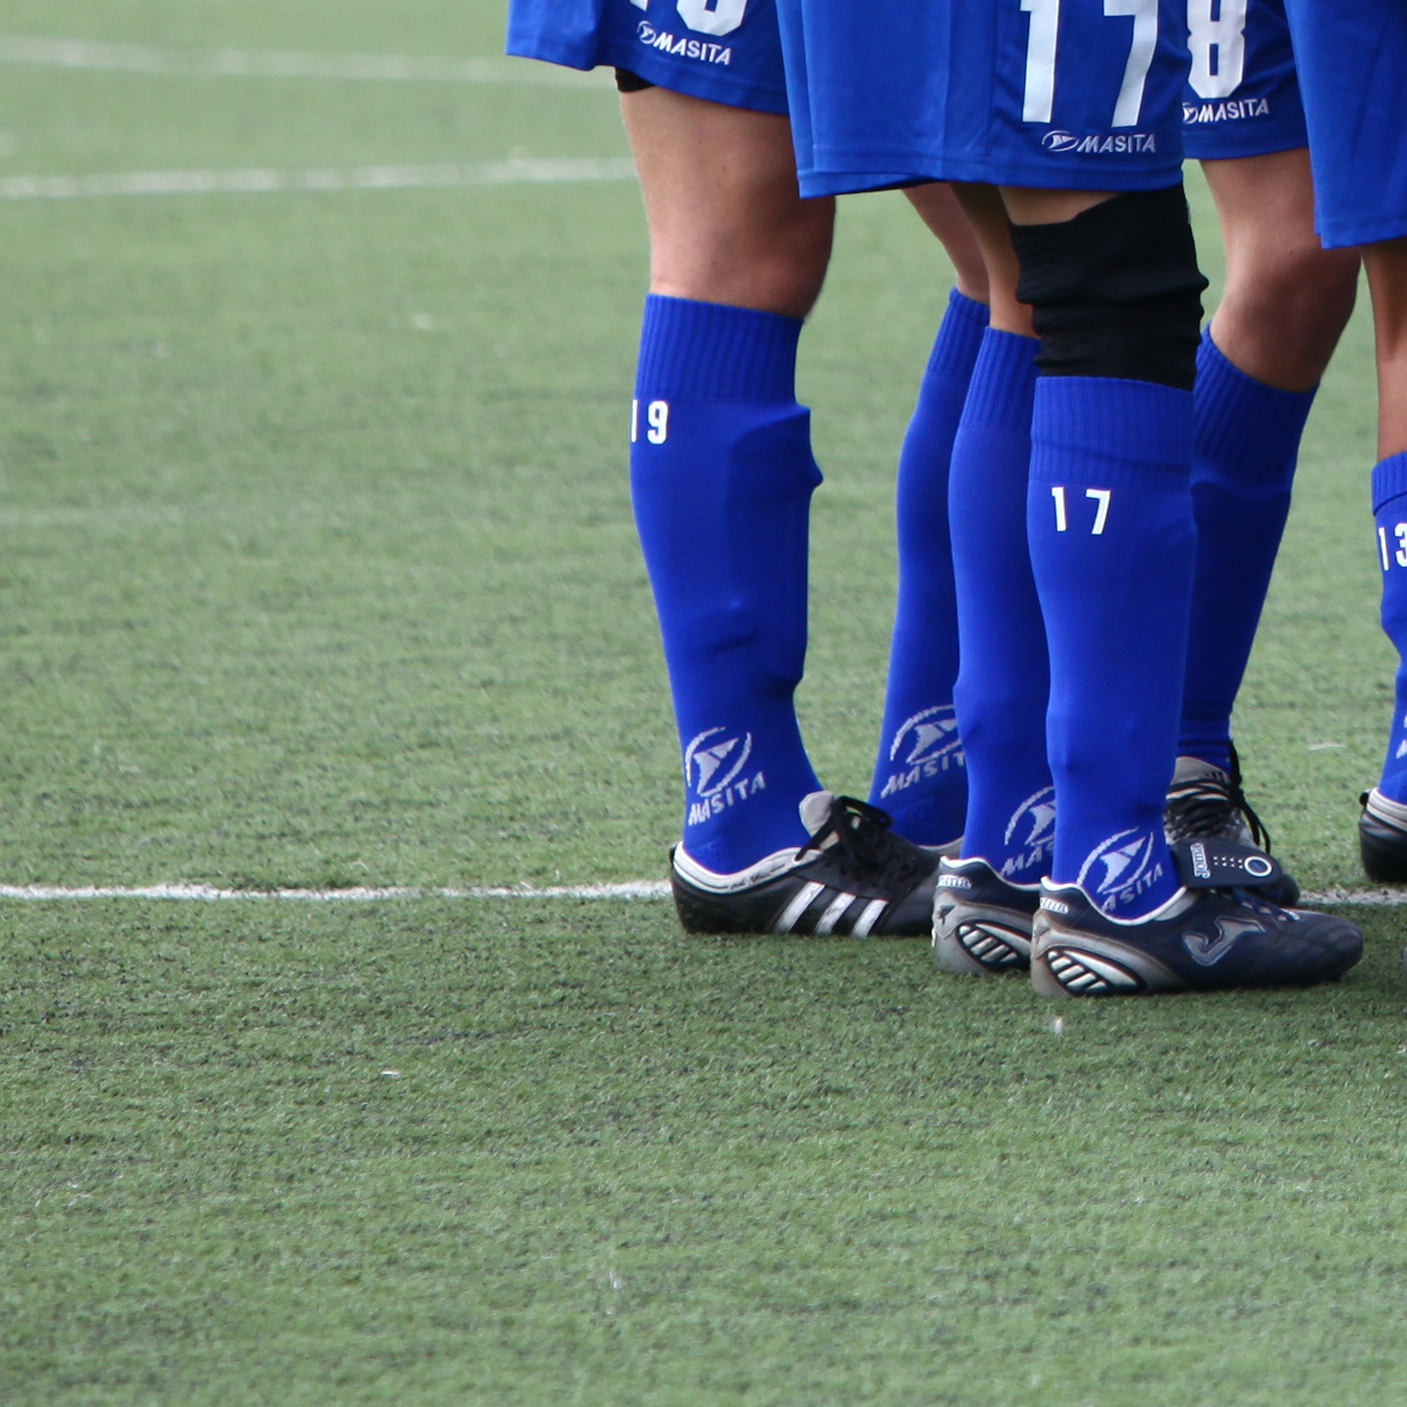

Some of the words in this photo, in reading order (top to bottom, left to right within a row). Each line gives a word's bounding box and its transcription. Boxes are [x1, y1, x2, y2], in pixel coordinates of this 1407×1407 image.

[653, 30, 732, 66] MASITA
[1196, 98, 1270, 124] MASITA
[1077, 132, 1157, 155] MASITA
[632, 399, 669, 445] 19
[1051, 486, 1112, 535] 17
[688, 771, 766, 826] MASITA
[1101, 862, 1164, 914] ASITA
